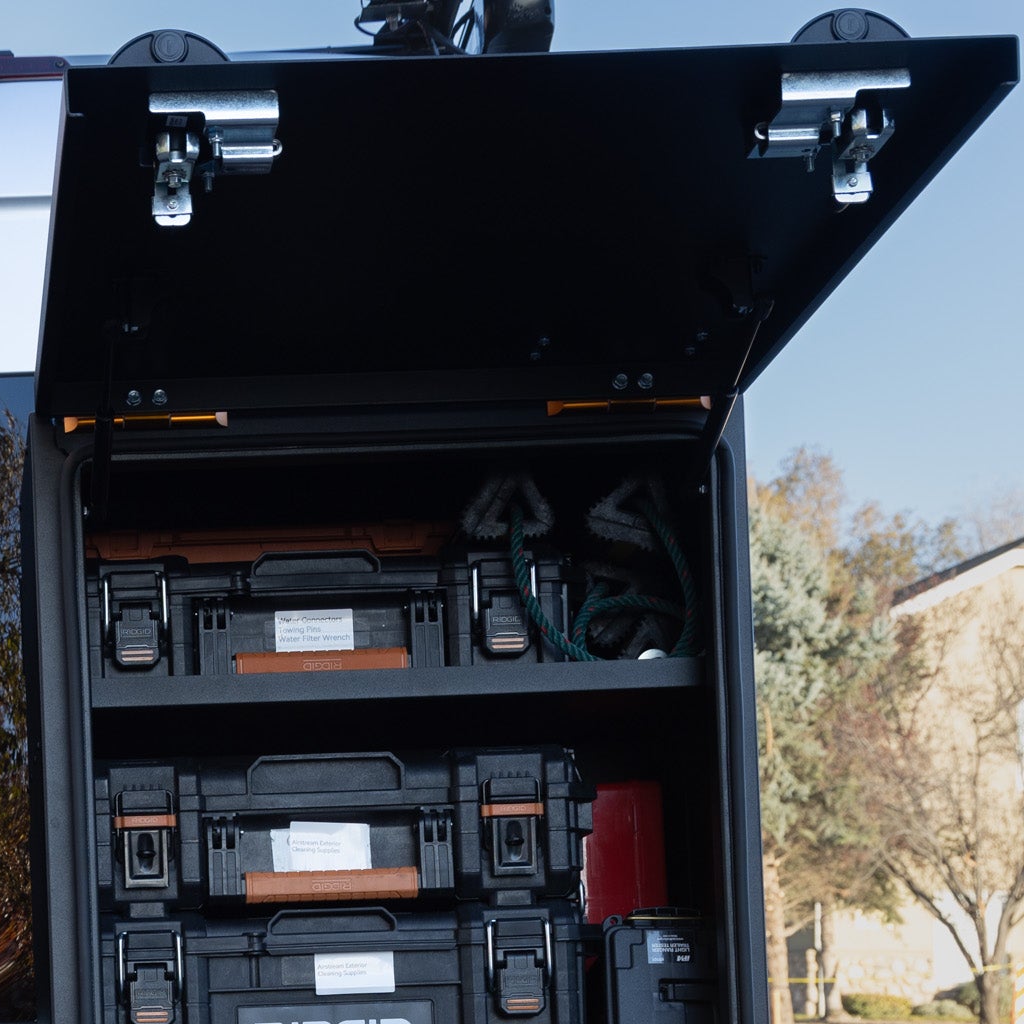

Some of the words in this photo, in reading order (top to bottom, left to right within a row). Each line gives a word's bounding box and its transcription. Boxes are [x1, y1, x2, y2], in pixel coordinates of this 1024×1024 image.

[279, 627, 305, 635] Towing
[307, 625, 322, 633] Pins
[279, 635, 301, 643] Water
[303, 634, 321, 642] Filter
[323, 633, 351, 641] Wrench
